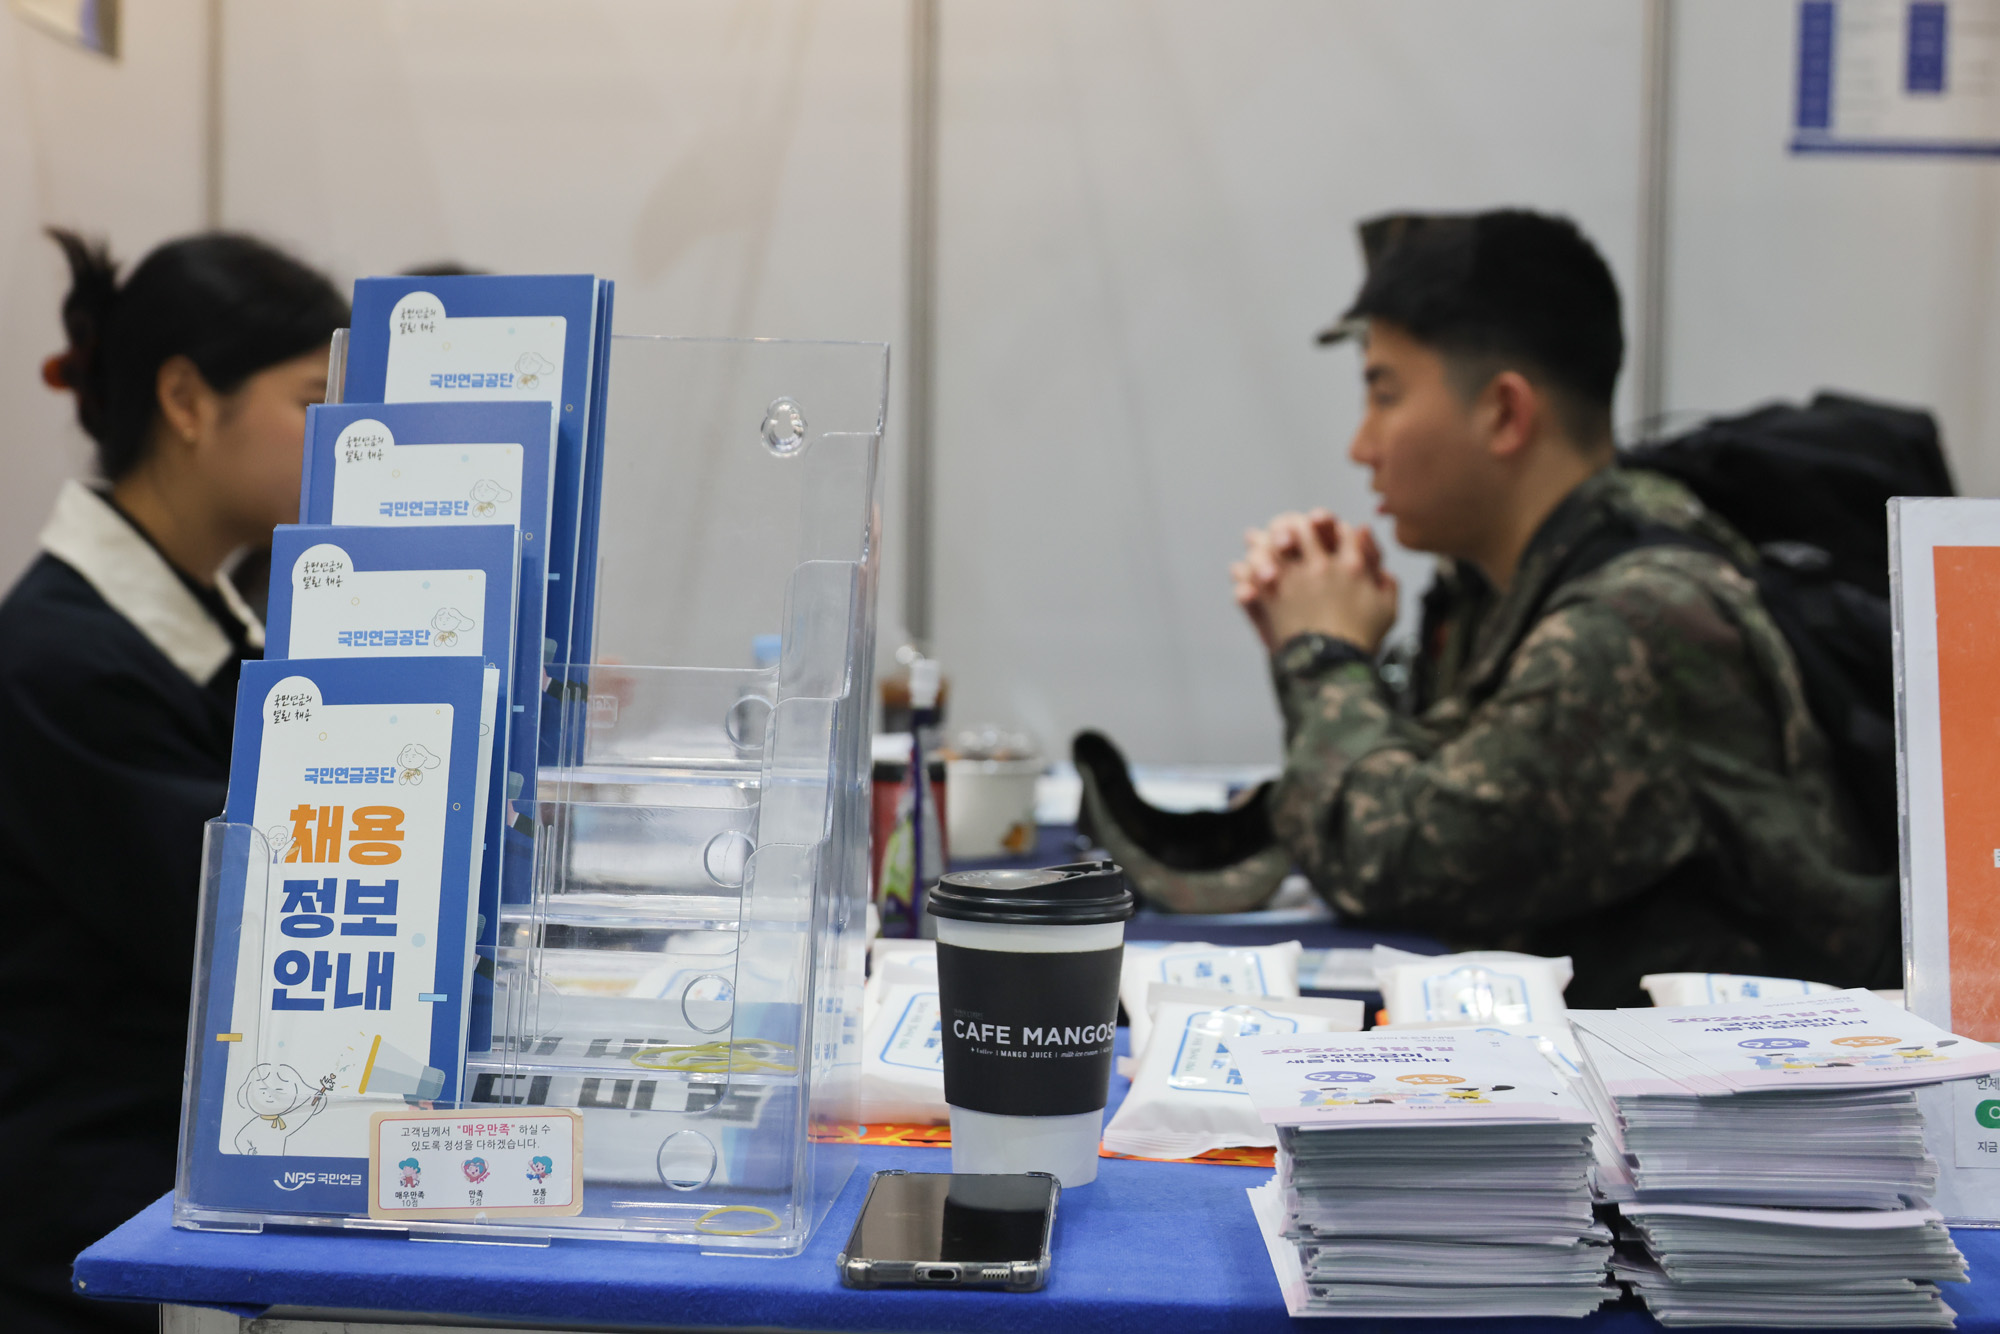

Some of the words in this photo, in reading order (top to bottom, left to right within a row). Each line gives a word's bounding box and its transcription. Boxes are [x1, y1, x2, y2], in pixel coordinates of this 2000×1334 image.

[430, 372, 514, 388] 국민연금공단
[346, 434, 384, 448] 국민연금의
[367, 448, 384, 462] 채용
[379, 500, 470, 518] 국민연금공단
[303, 560, 344, 574] 국민연금의
[302, 576, 322, 590] 열린
[325, 574, 344, 588] 채용
[338, 630, 431, 647] 국민연금공단
[274, 693, 313, 708] 국민연금의
[273, 710, 291, 724] 열린
[294, 708, 312, 722] 채용
[304, 766, 397, 784] 국민연금공단
[284, 804, 405, 865] 채용
[280, 877, 399, 939] 정보
[271, 949, 395, 1011] 안내
[953, 1019, 1011, 1045] CAFE
[1000, 1050, 1028, 1058] MANGO
[1030, 1050, 1052, 1059] JUICE
[400, 1126, 451, 1138] 고객님께서
[518, 1124, 538, 1136] 하실
[541, 1124, 552, 1135] 수
[411, 1140, 441, 1152] 있도록
[444, 1140, 474, 1152] 정성을
[476, 1138, 540, 1150] 다하겠습니다.
[1978, 1141, 1998, 1153] 지금
[283, 1172, 316, 1187] NPS
[317, 1172, 361, 1186] 국민연금
[395, 1190, 426, 1200] 매우만족
[468, 1189, 484, 1199] 만족
[532, 1188, 548, 1197] 보통
[401, 1199, 418, 1208] 10점
[469, 1198, 482, 1207] 9점
[533, 1196, 546, 1206] 8점
